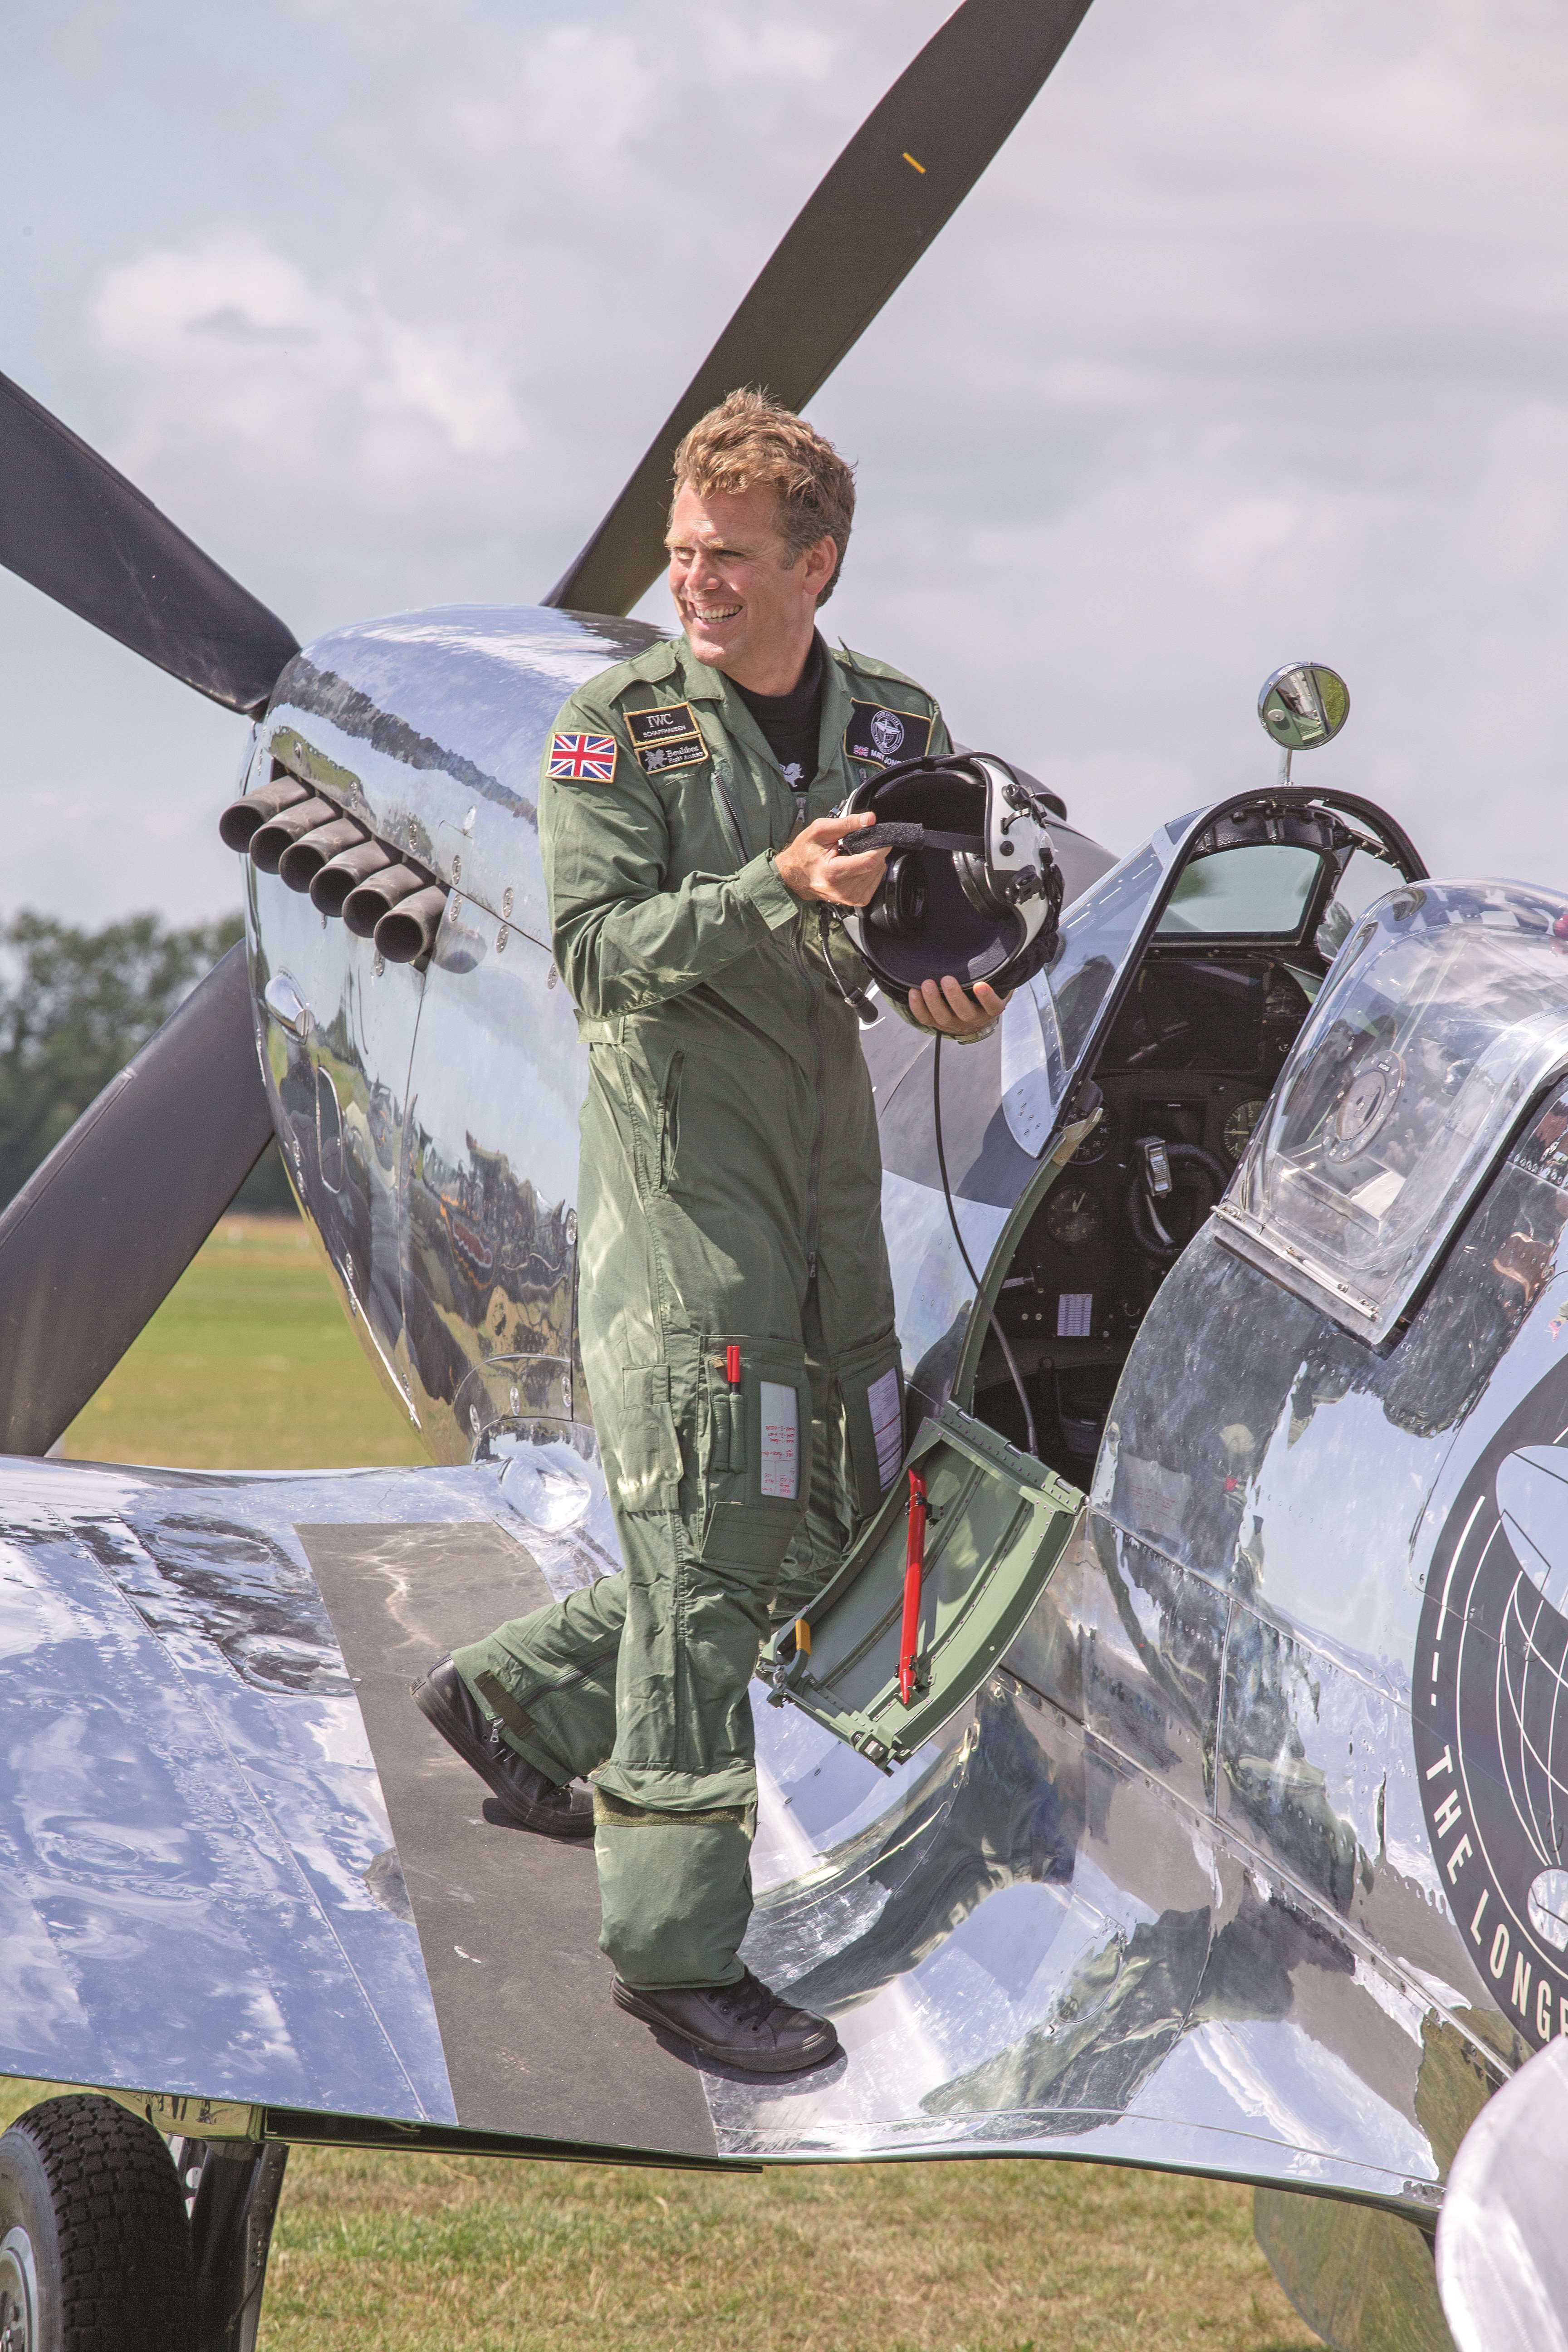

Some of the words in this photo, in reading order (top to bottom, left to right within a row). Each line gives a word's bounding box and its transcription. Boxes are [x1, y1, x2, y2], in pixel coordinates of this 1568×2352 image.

[646, 713, 674, 728] IWC
[642, 725, 686, 738] SCHAFFHAUSEN
[1426, 1744, 1473, 1885] THE
